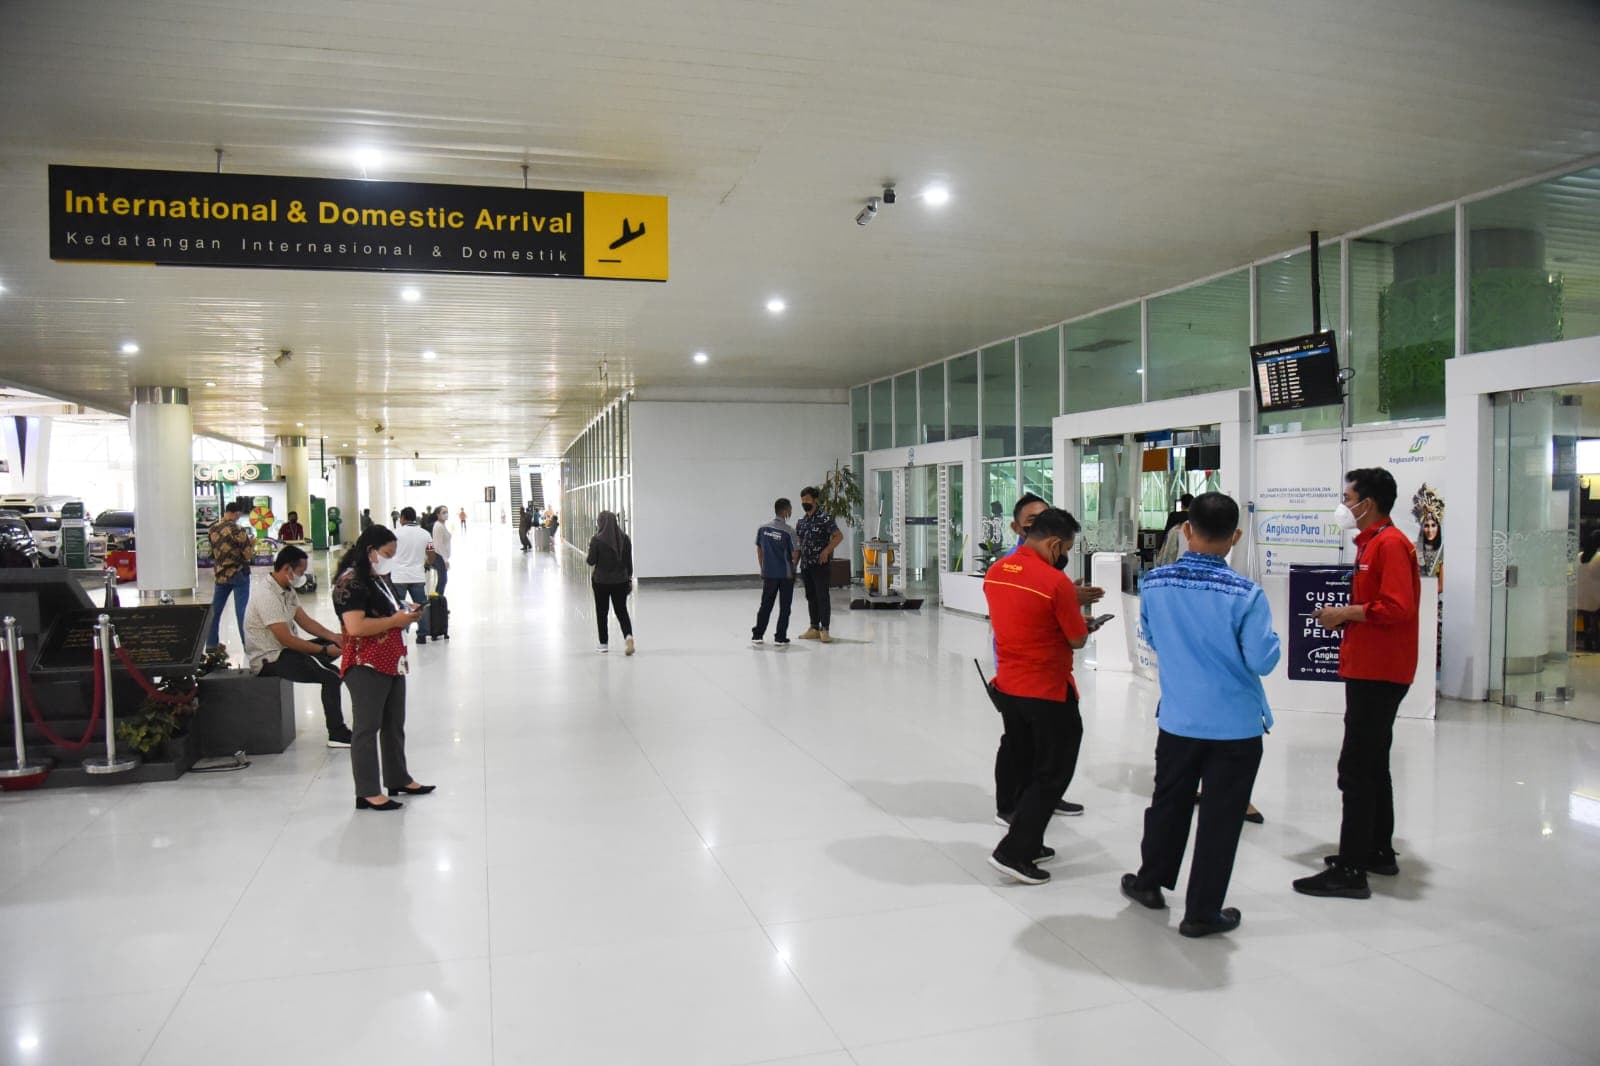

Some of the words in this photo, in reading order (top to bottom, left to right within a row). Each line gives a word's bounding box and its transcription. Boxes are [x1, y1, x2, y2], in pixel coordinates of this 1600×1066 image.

[65, 189, 277, 222] International
[287, 200, 308, 223] &
[319, 201, 464, 229] Domestic
[475, 209, 572, 234] Arrival
[67, 232, 221, 251] Kedatangan
[242, 238, 412, 256] Internasional
[432, 246, 442, 257] &
[462, 246, 567, 262] Domestik
[194, 464, 260, 482] Grab
[1267, 523, 1300, 536] Angkasa
[1301, 524, 1320, 535] Pura
[1303, 629, 1344, 638] PELA
[1315, 651, 1339, 660] Angka
